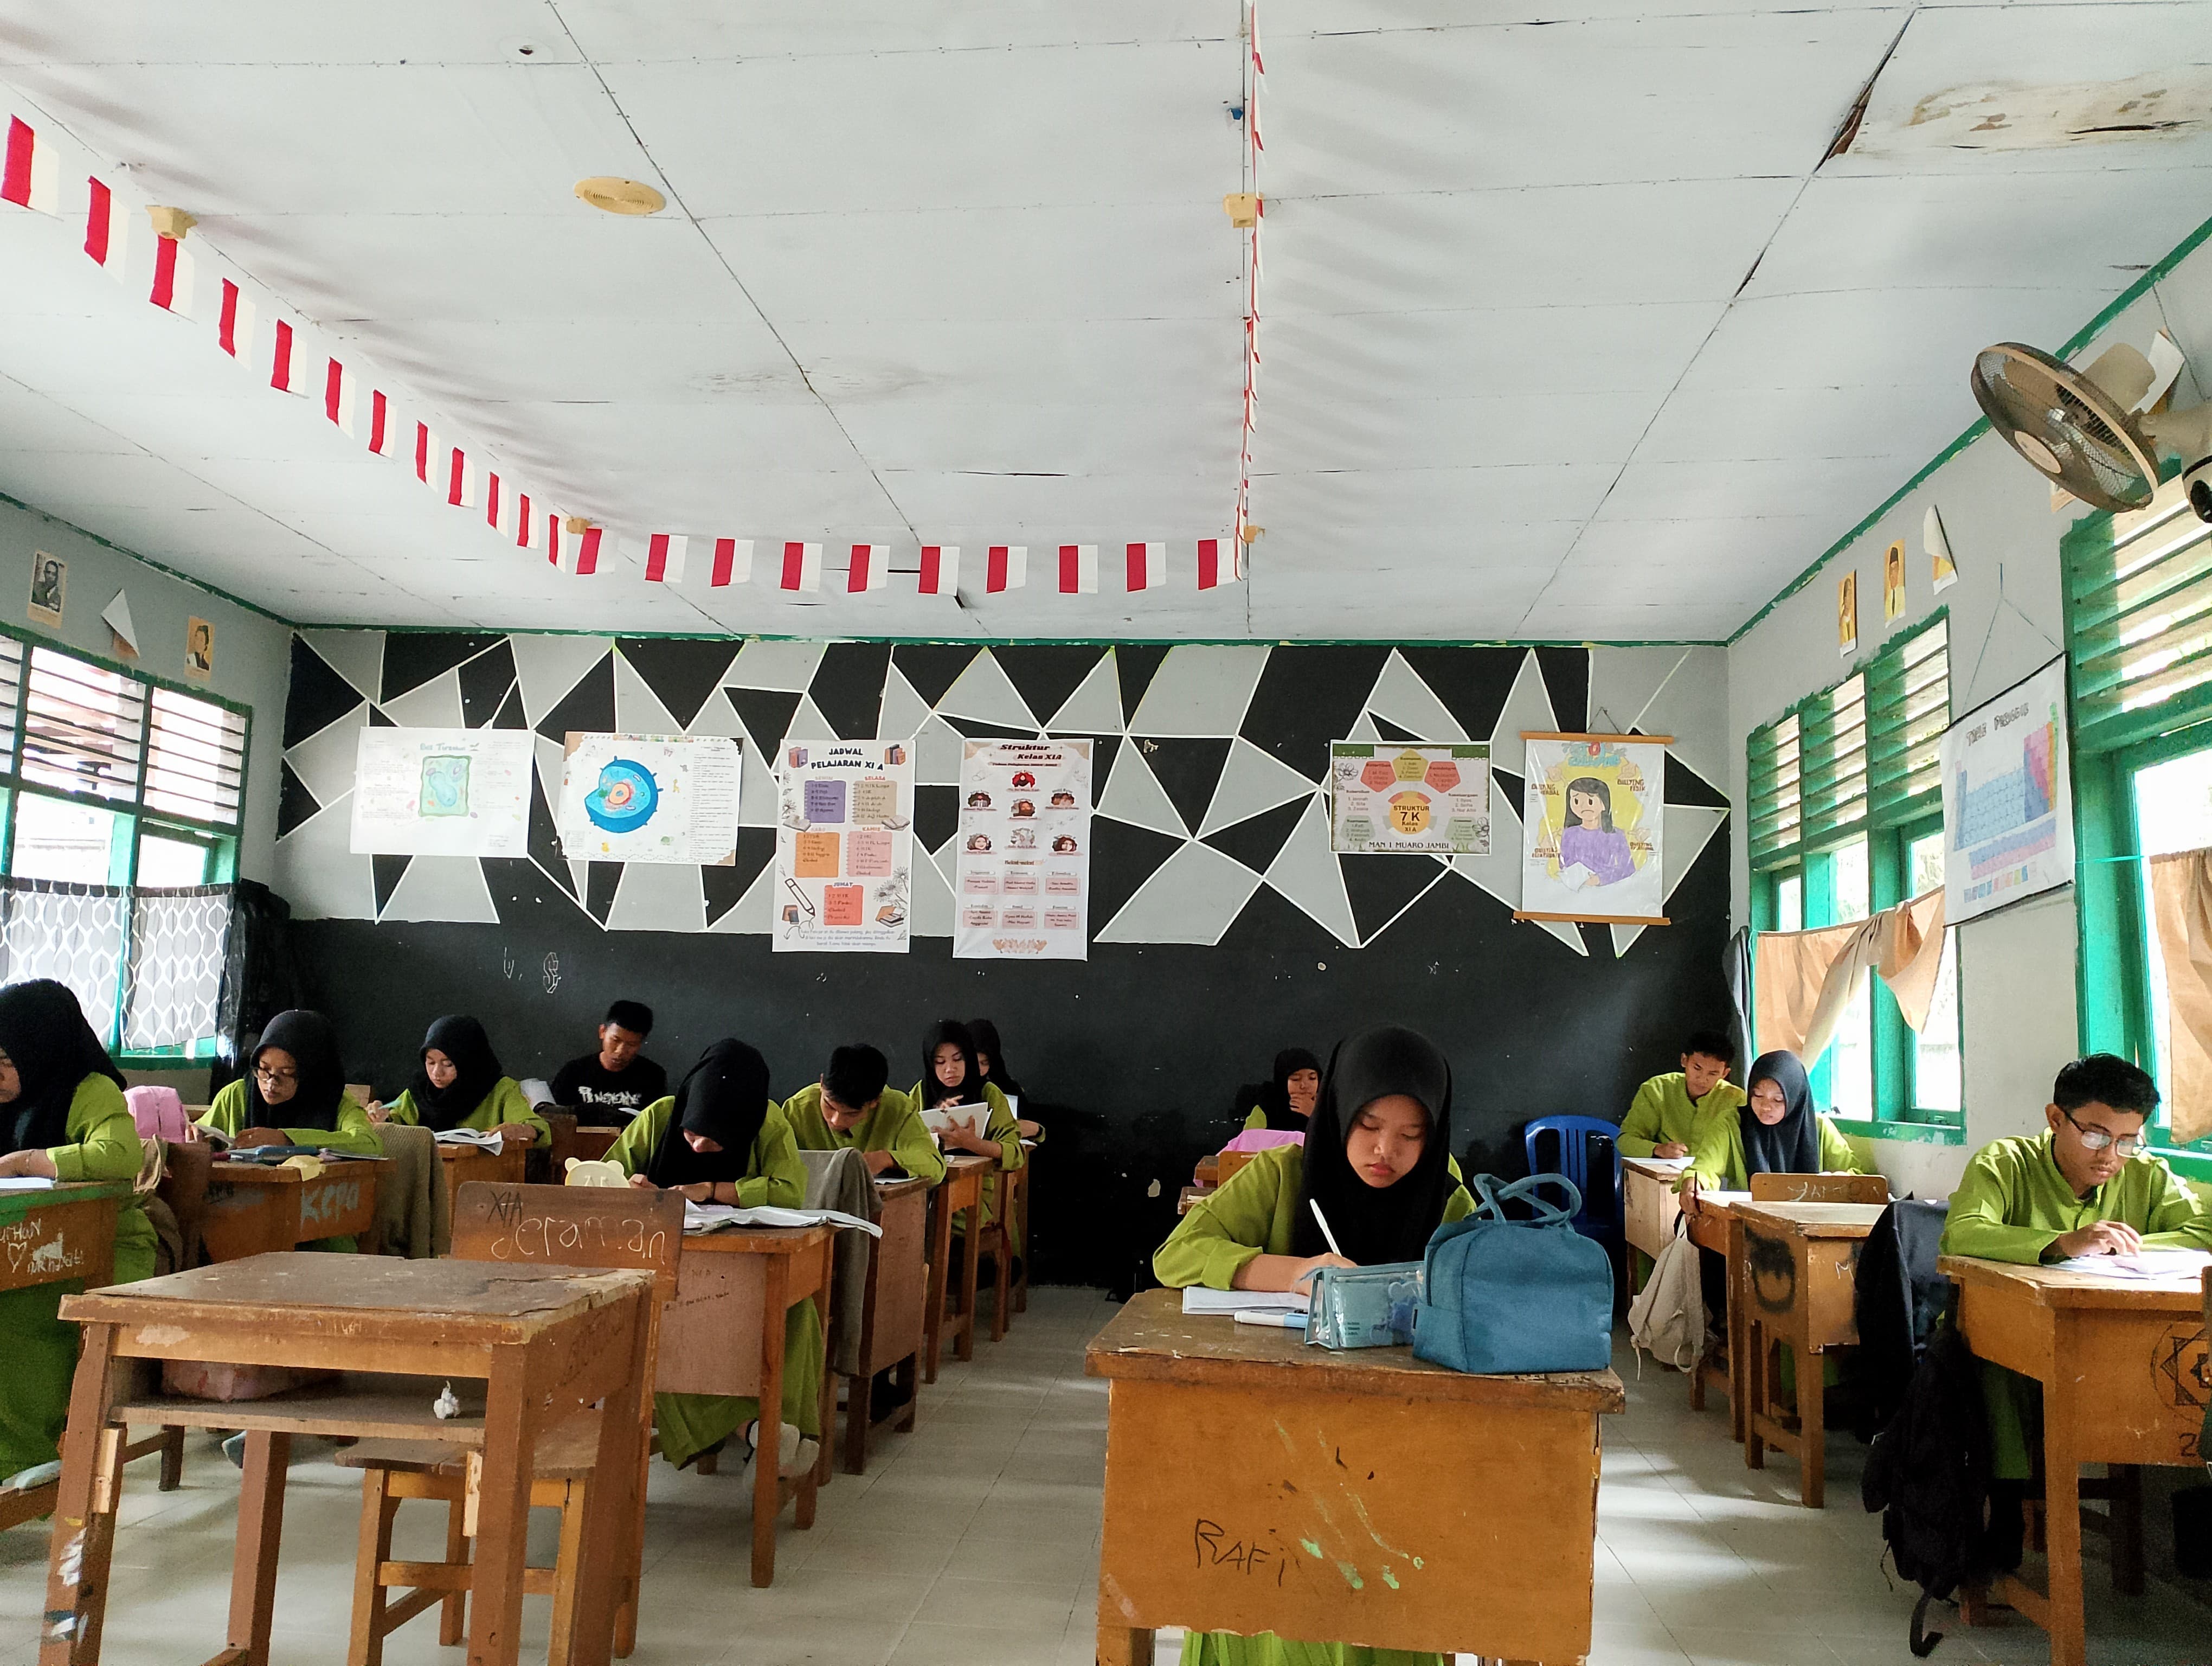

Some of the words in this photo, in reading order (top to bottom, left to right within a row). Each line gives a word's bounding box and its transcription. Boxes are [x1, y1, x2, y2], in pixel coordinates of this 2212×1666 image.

[811, 760, 861, 769] PELAJARAN
[864, 761, 874, 769] XI
[1400, 812, 1408, 821] 7
[1411, 812, 1419, 822] K
